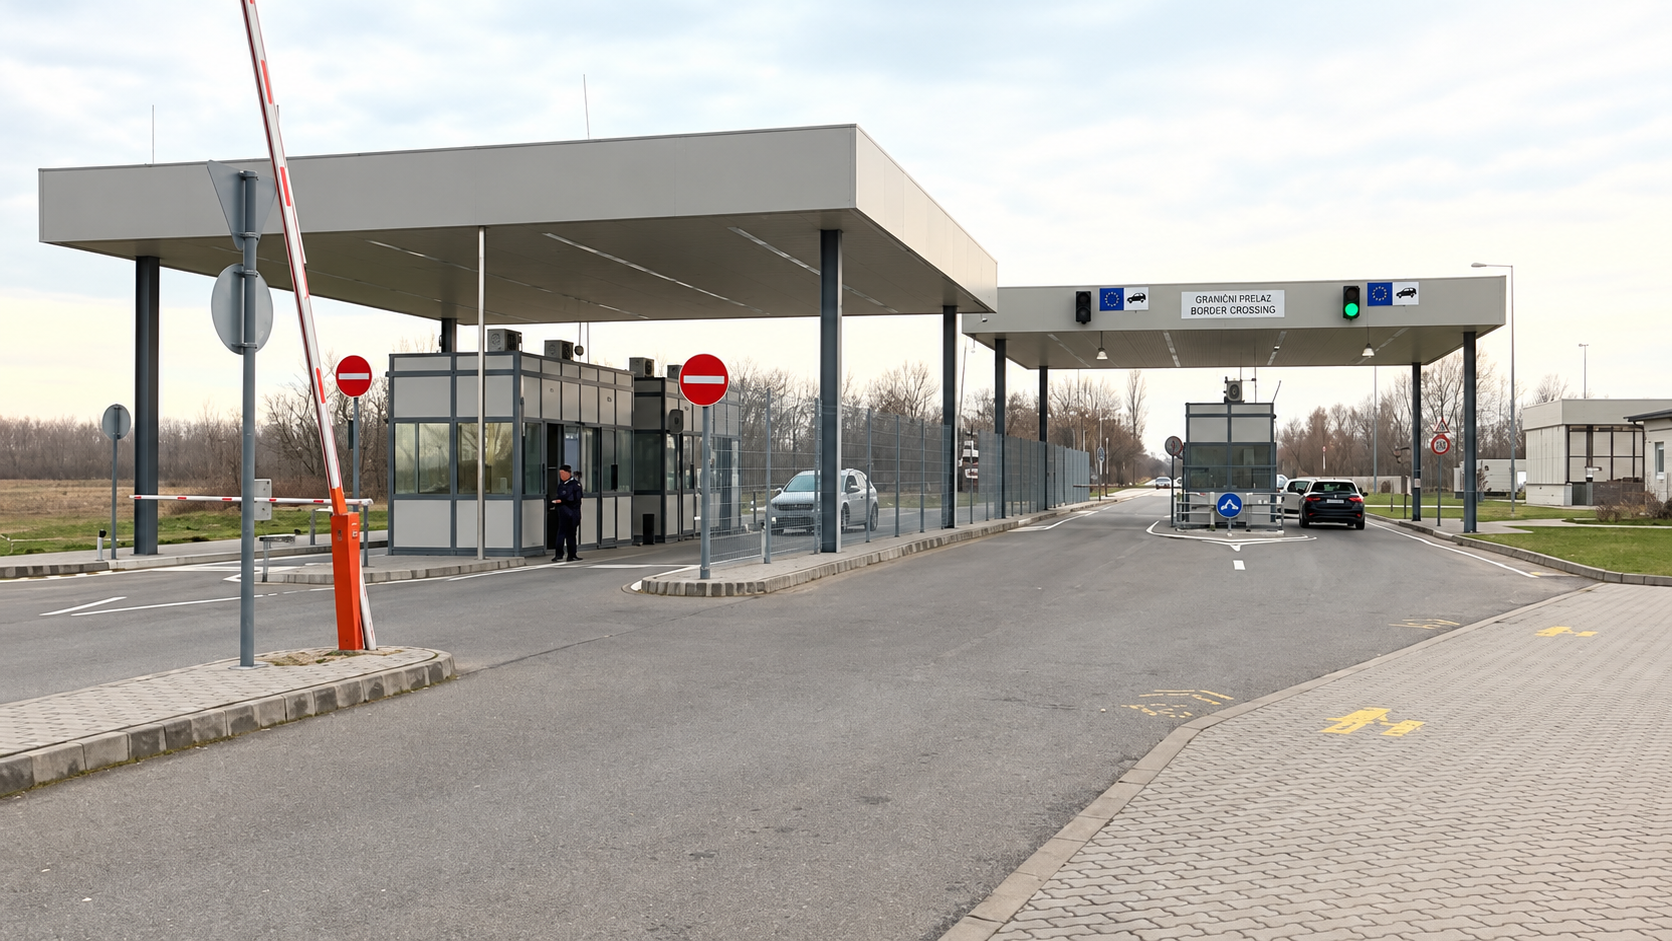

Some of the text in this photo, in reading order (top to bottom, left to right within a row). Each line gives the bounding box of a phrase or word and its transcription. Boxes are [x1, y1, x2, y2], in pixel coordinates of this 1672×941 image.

[1239, 294, 1272, 303] PRELAZ
[1190, 305, 1276, 315] BORDER CROSSING
